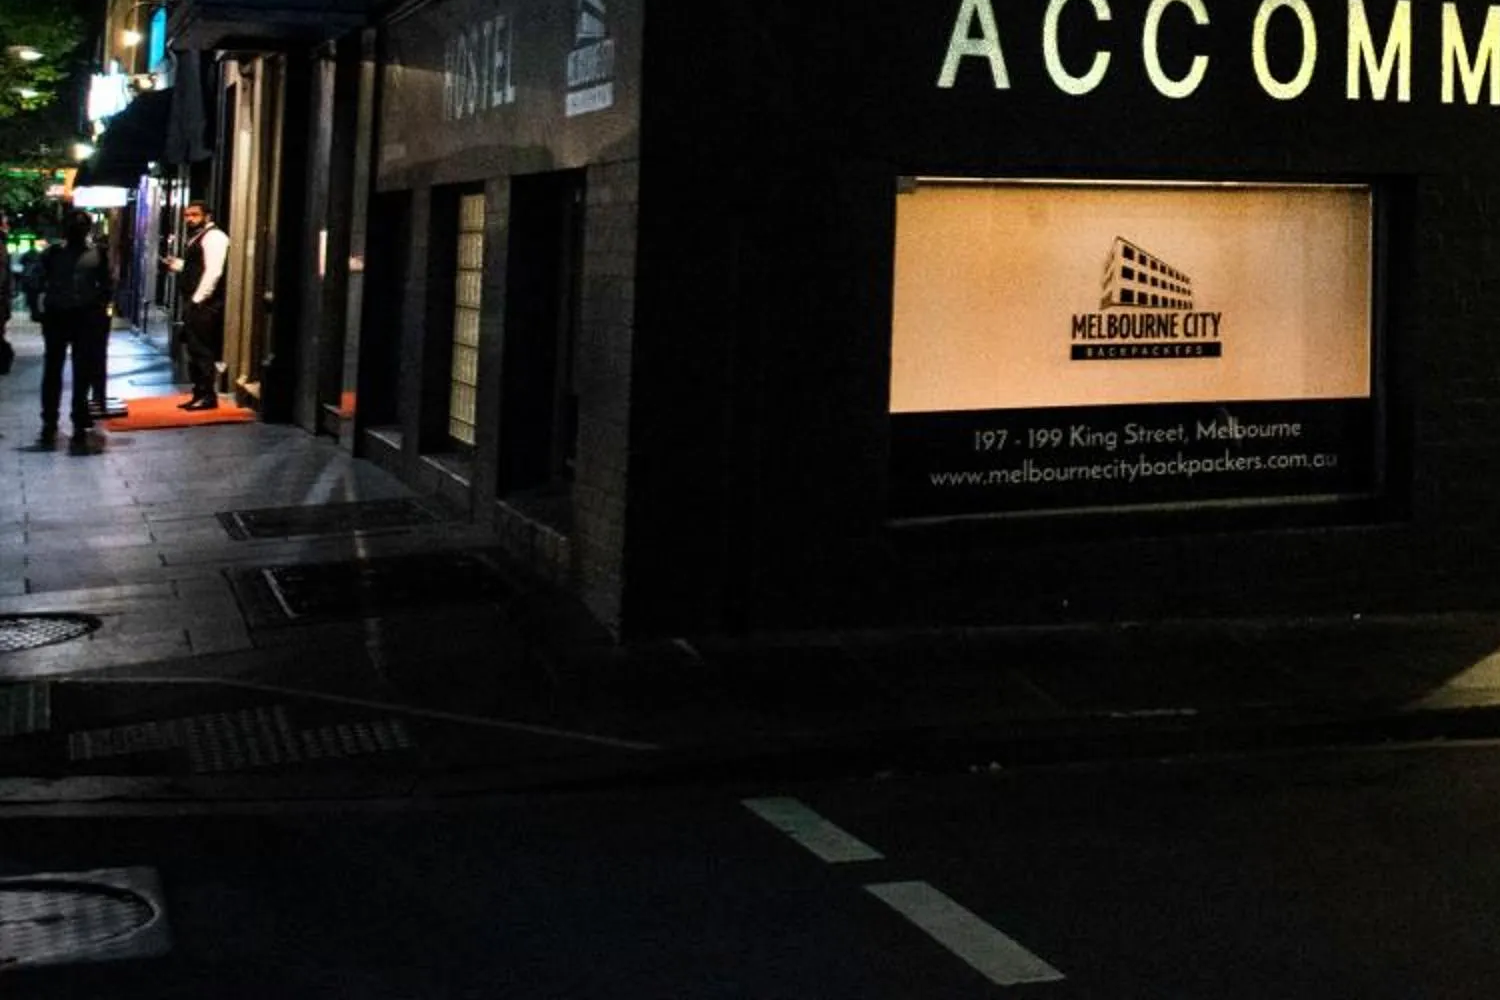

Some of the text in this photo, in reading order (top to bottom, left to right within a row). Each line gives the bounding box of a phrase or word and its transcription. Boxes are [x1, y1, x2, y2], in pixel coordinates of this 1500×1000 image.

[1071, 311, 1223, 340] MELBOURNE CITY
[1086, 345, 1204, 358] BACKPACKERS
[974, 430, 1008, 451] 197
[1028, 428, 1062, 449] 199
[1070, 424, 1117, 451] King
[1124, 423, 1189, 446] Street,
[1196, 415, 1302, 440] Melbourne
[929, 449, 1338, 487] www.melbournecitybackpackers.com.au
